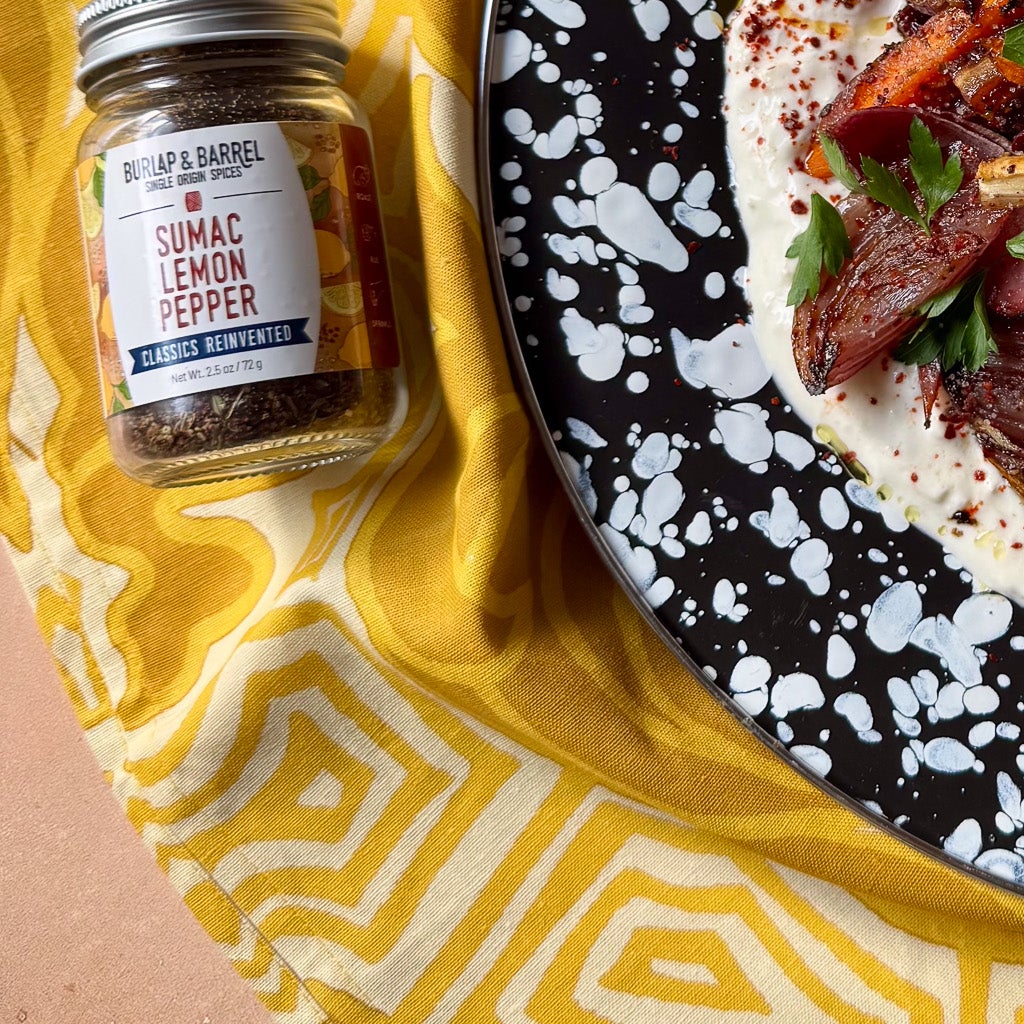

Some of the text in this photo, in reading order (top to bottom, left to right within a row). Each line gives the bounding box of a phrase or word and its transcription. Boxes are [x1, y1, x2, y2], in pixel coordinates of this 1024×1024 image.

[123, 140, 265, 184] BURLAP & BARREL
[146, 166, 243, 193] SINGLE ORIGIN SPICES
[155, 212, 244, 258] SUMAC
[160, 247, 248, 294] LEMON
[159, 283, 259, 332] PEPPER
[141, 324, 293, 368] CLASSICS REINVENTED
[171, 371, 187, 384] Net
[189, 368, 204, 381] Wt.
[206, 365, 222, 378] 2.5
[223, 364, 235, 373] oz
[242, 359, 255, 372] 72
[256, 359, 263, 371] g
